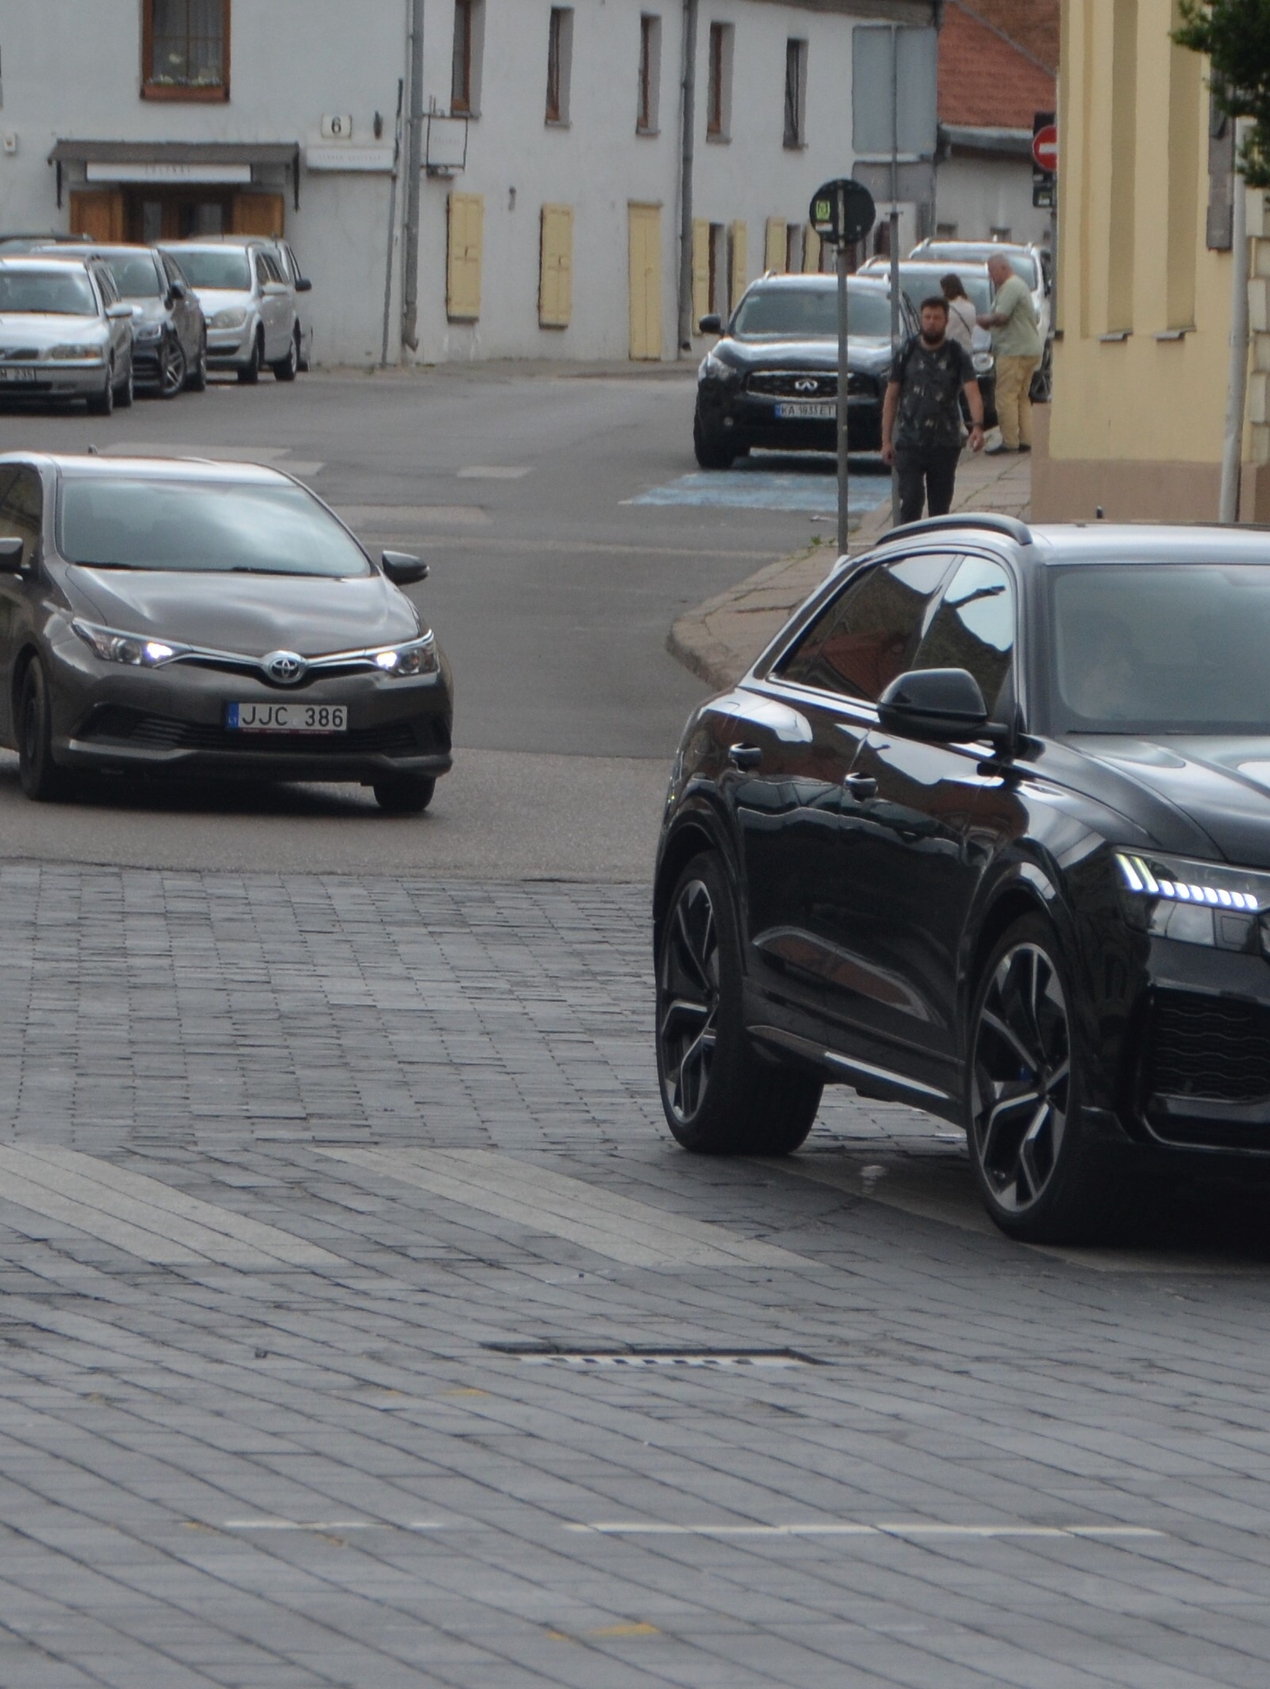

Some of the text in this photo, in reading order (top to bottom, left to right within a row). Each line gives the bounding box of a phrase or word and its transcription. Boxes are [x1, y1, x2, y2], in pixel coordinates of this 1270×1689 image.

[331, 116, 342, 134] 6
[242, 706, 343, 728] JJC 386
